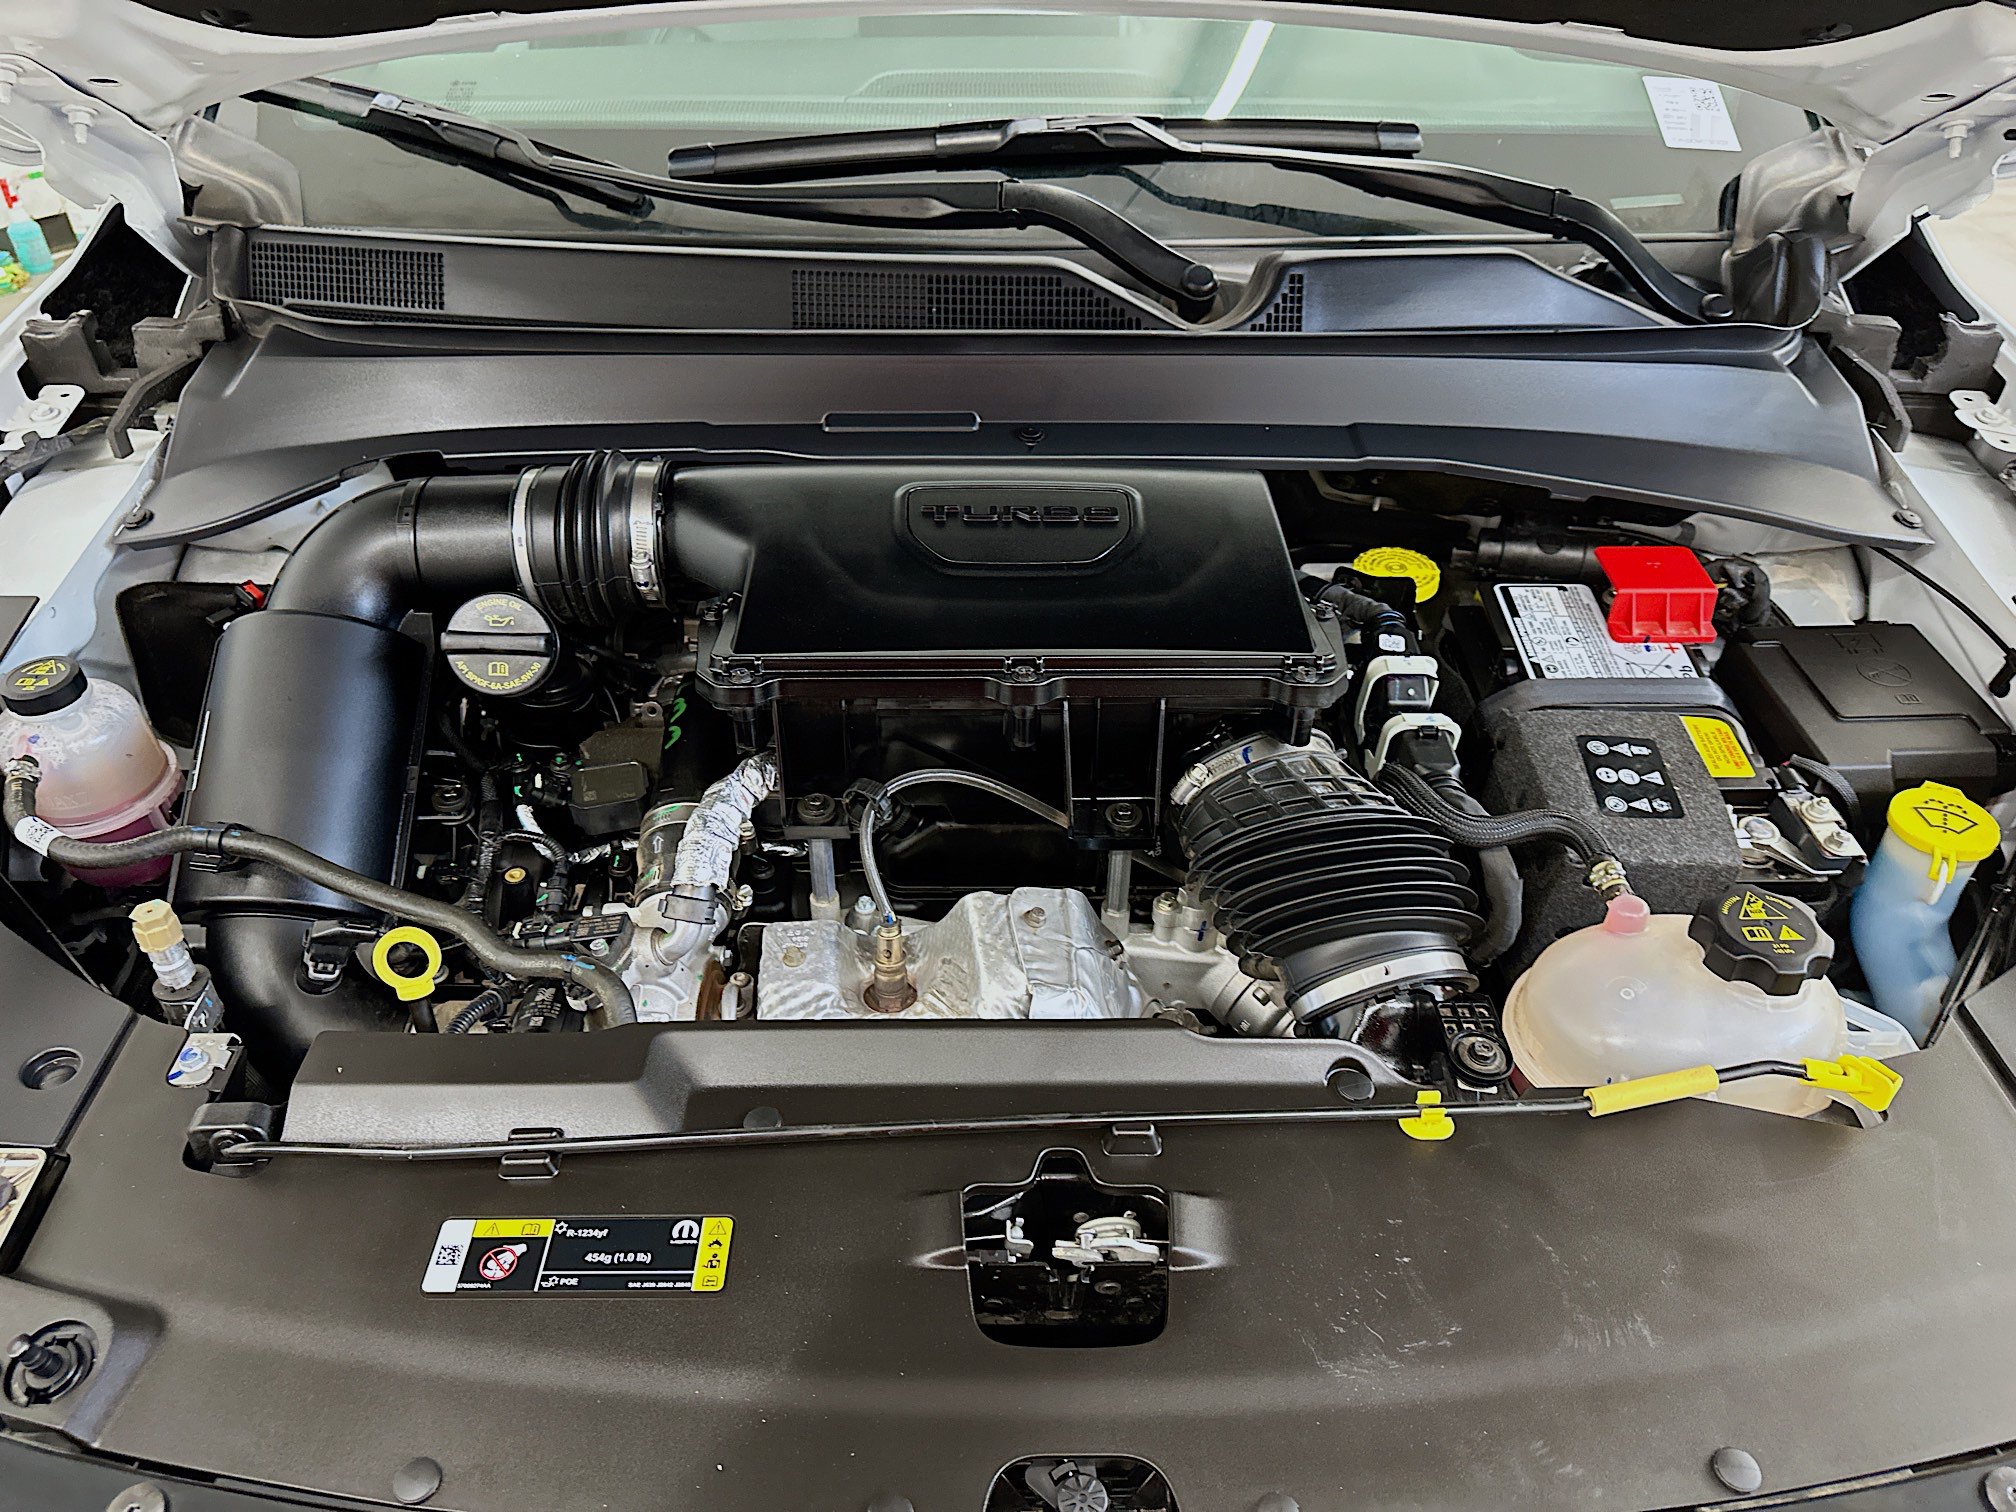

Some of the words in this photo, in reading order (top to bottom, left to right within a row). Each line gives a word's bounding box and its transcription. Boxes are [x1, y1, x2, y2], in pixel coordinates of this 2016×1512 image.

[920, 504, 1120, 523] TURBO
[475, 598, 508, 612] ENGINE
[508, 600, 523, 611] OIL
[565, 1228, 609, 1239] R-1234yf
[584, 1252, 612, 1264] 454g
[613, 1252, 634, 1265] (1.0
[635, 1252, 652, 1264] lb)
[559, 1277, 579, 1286] POE
